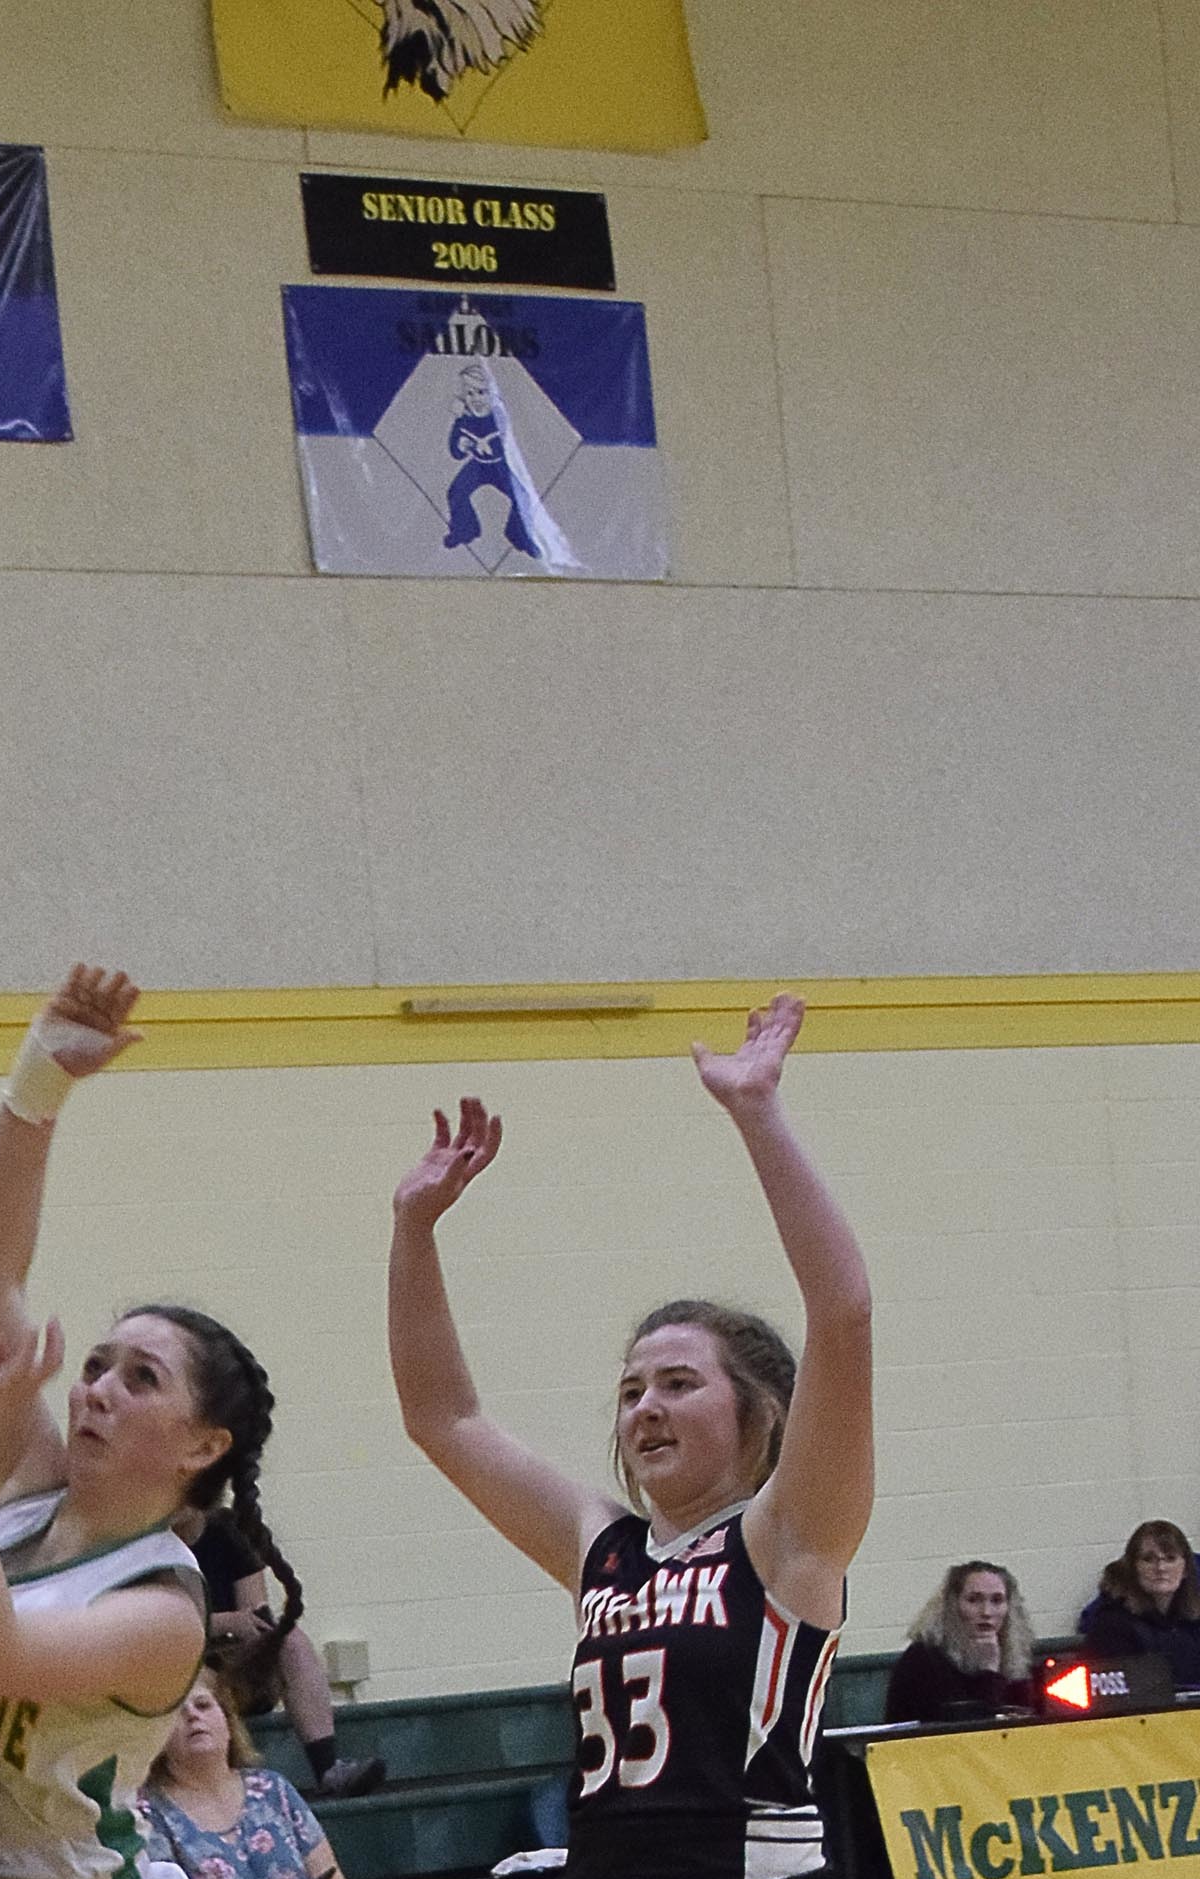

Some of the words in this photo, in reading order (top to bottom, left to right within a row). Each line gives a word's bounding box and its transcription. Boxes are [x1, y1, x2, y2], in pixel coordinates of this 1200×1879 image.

[361, 192, 468, 225] SENIOR
[472, 200, 556, 232] CLASS
[431, 242, 499, 273] 2006
[573, 1647, 671, 1799] 33
